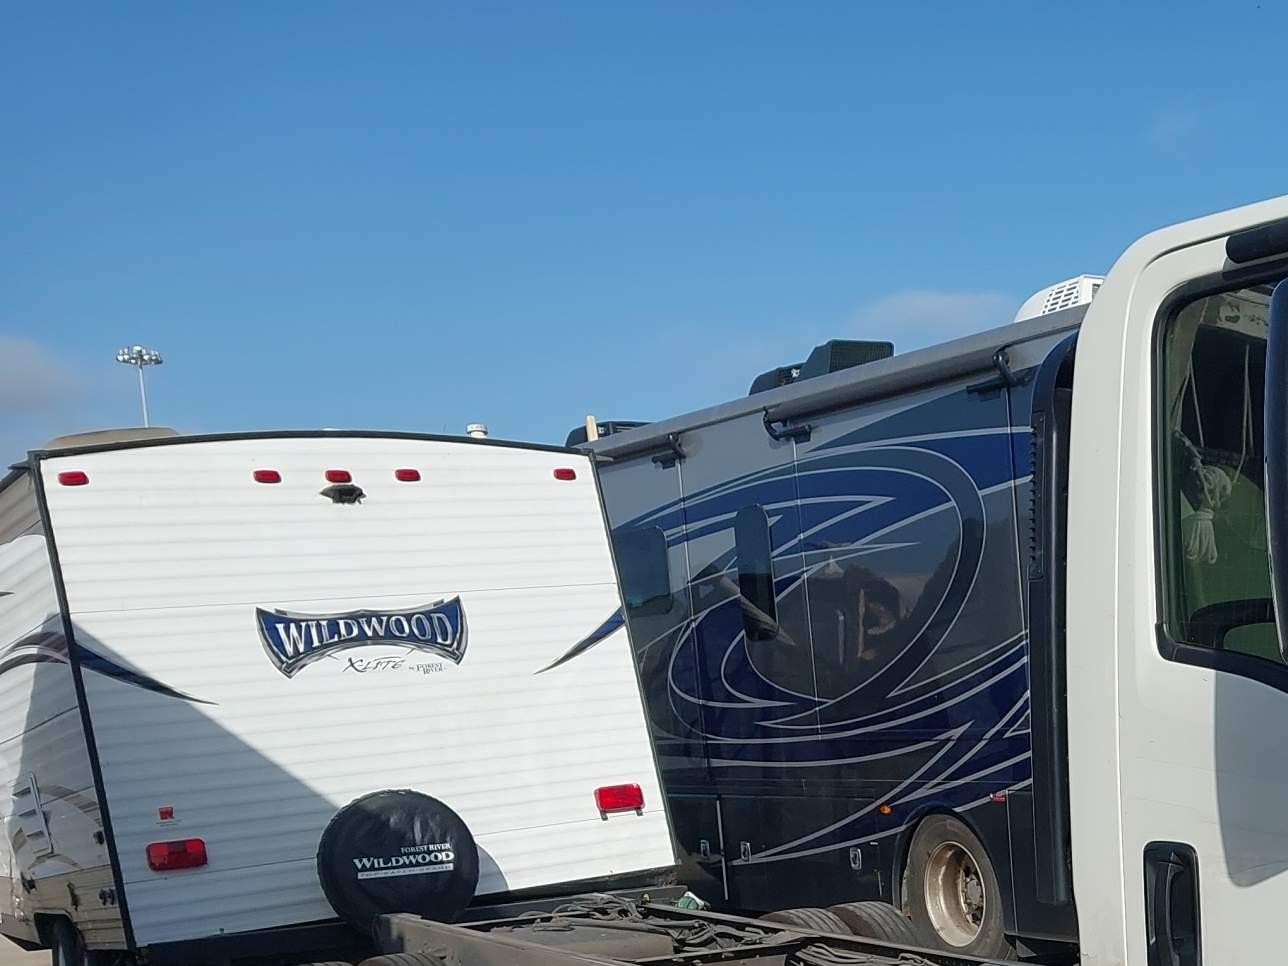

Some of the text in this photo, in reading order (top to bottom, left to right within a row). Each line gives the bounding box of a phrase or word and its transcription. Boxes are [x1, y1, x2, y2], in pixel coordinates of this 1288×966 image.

[275, 613, 452, 657] WILDWOOD
[400, 843, 451, 854] FOREST RIVER
[353, 851, 455, 870] WILDWOOD
